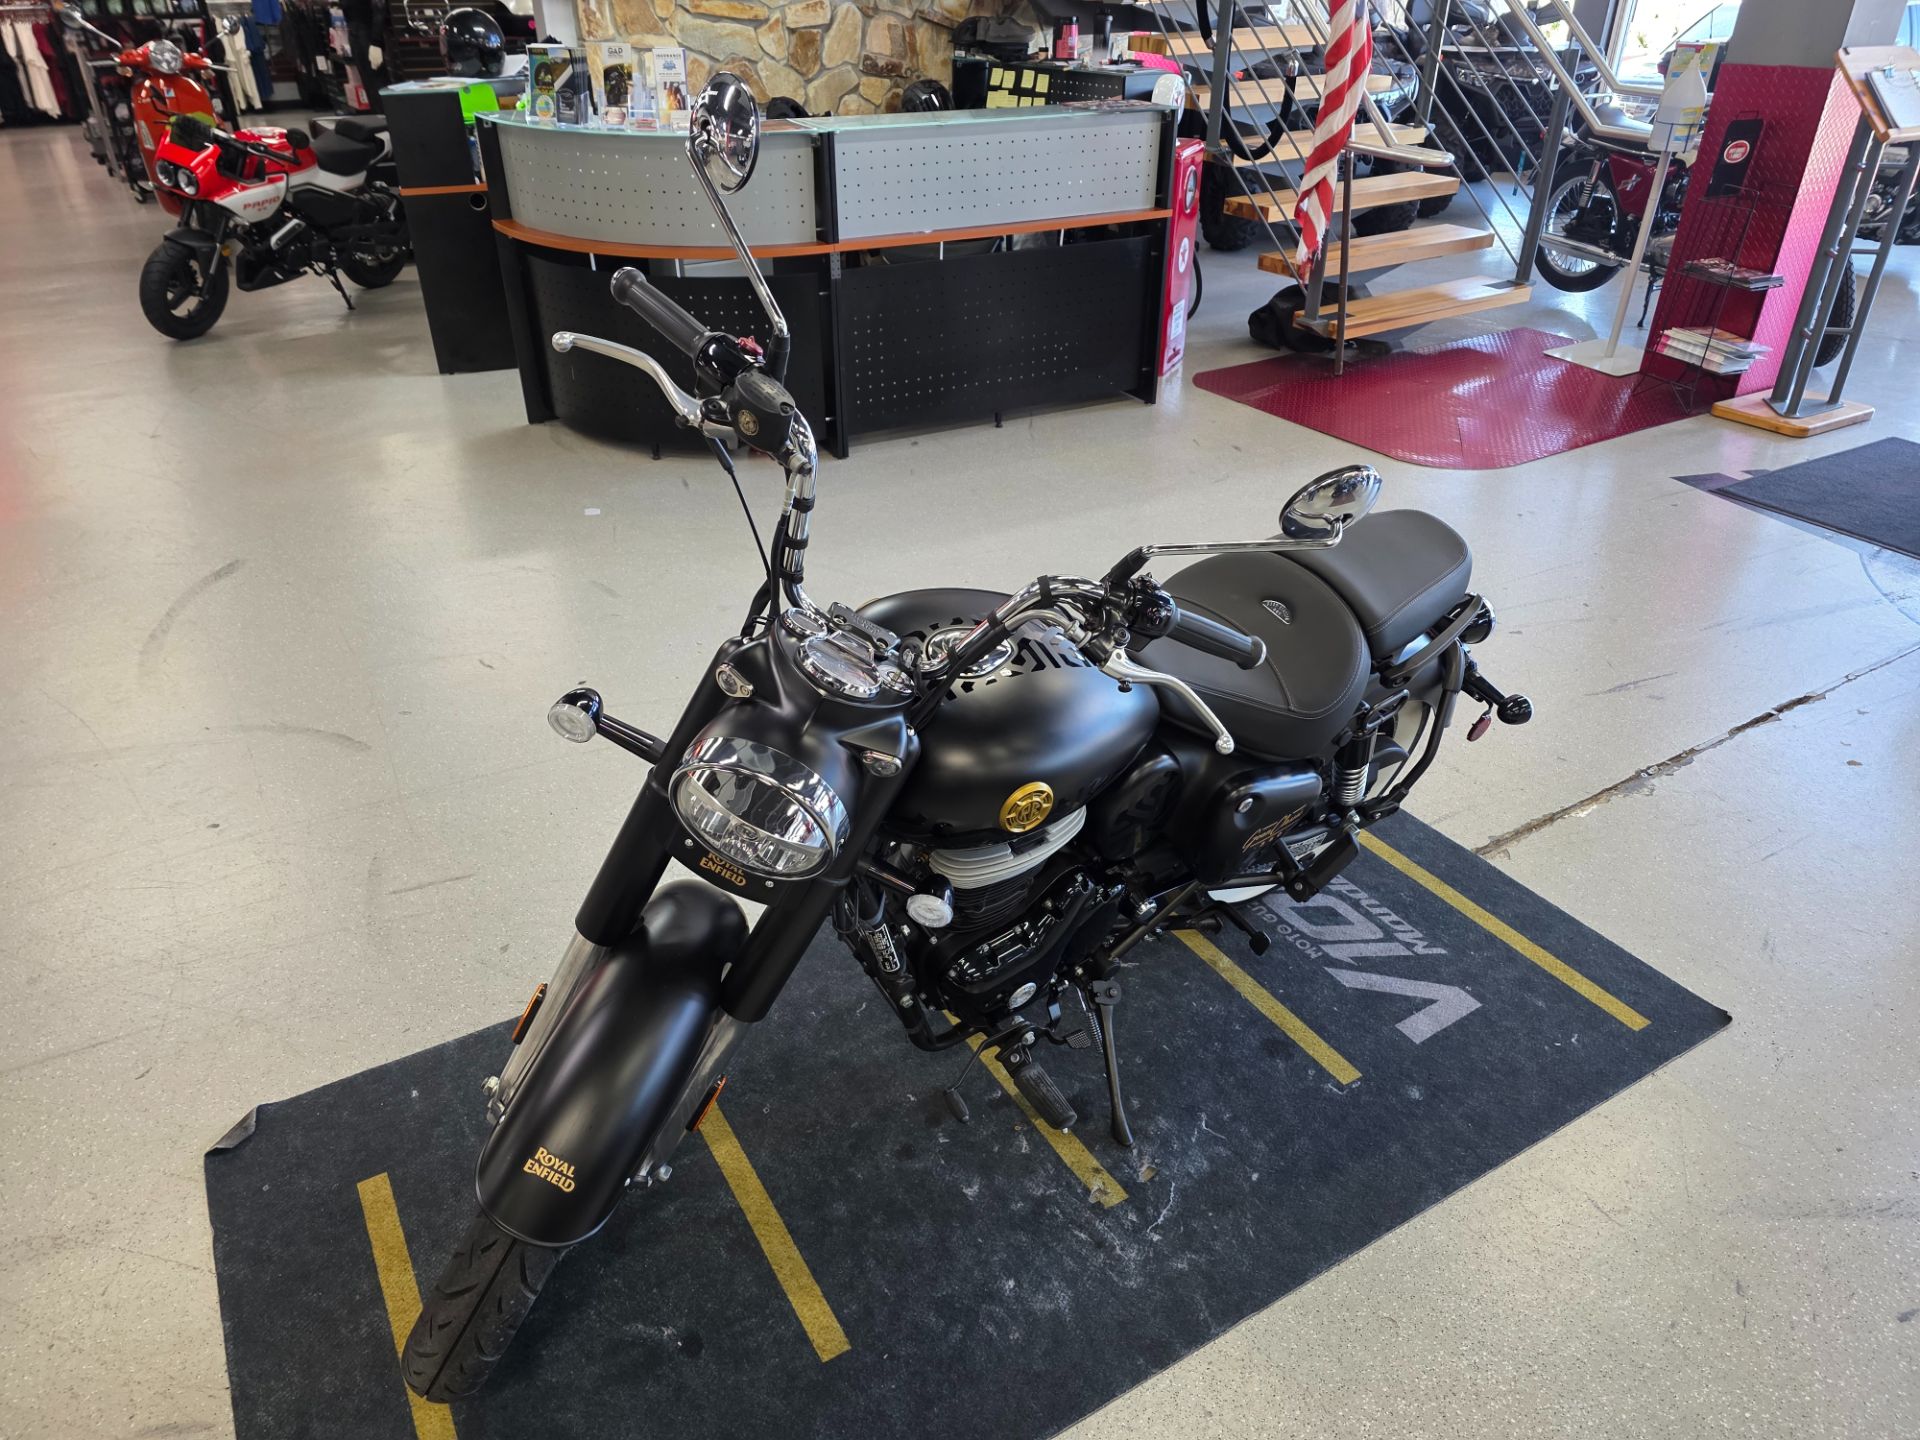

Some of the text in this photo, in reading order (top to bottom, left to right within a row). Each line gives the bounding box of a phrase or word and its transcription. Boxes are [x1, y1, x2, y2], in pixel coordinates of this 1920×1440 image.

[700, 857, 746, 886] ENFIELD
[1277, 924, 1323, 960] MOTO
[523, 1158, 576, 1192] ENFIELD
[534, 1146, 576, 1178] ROYAL
